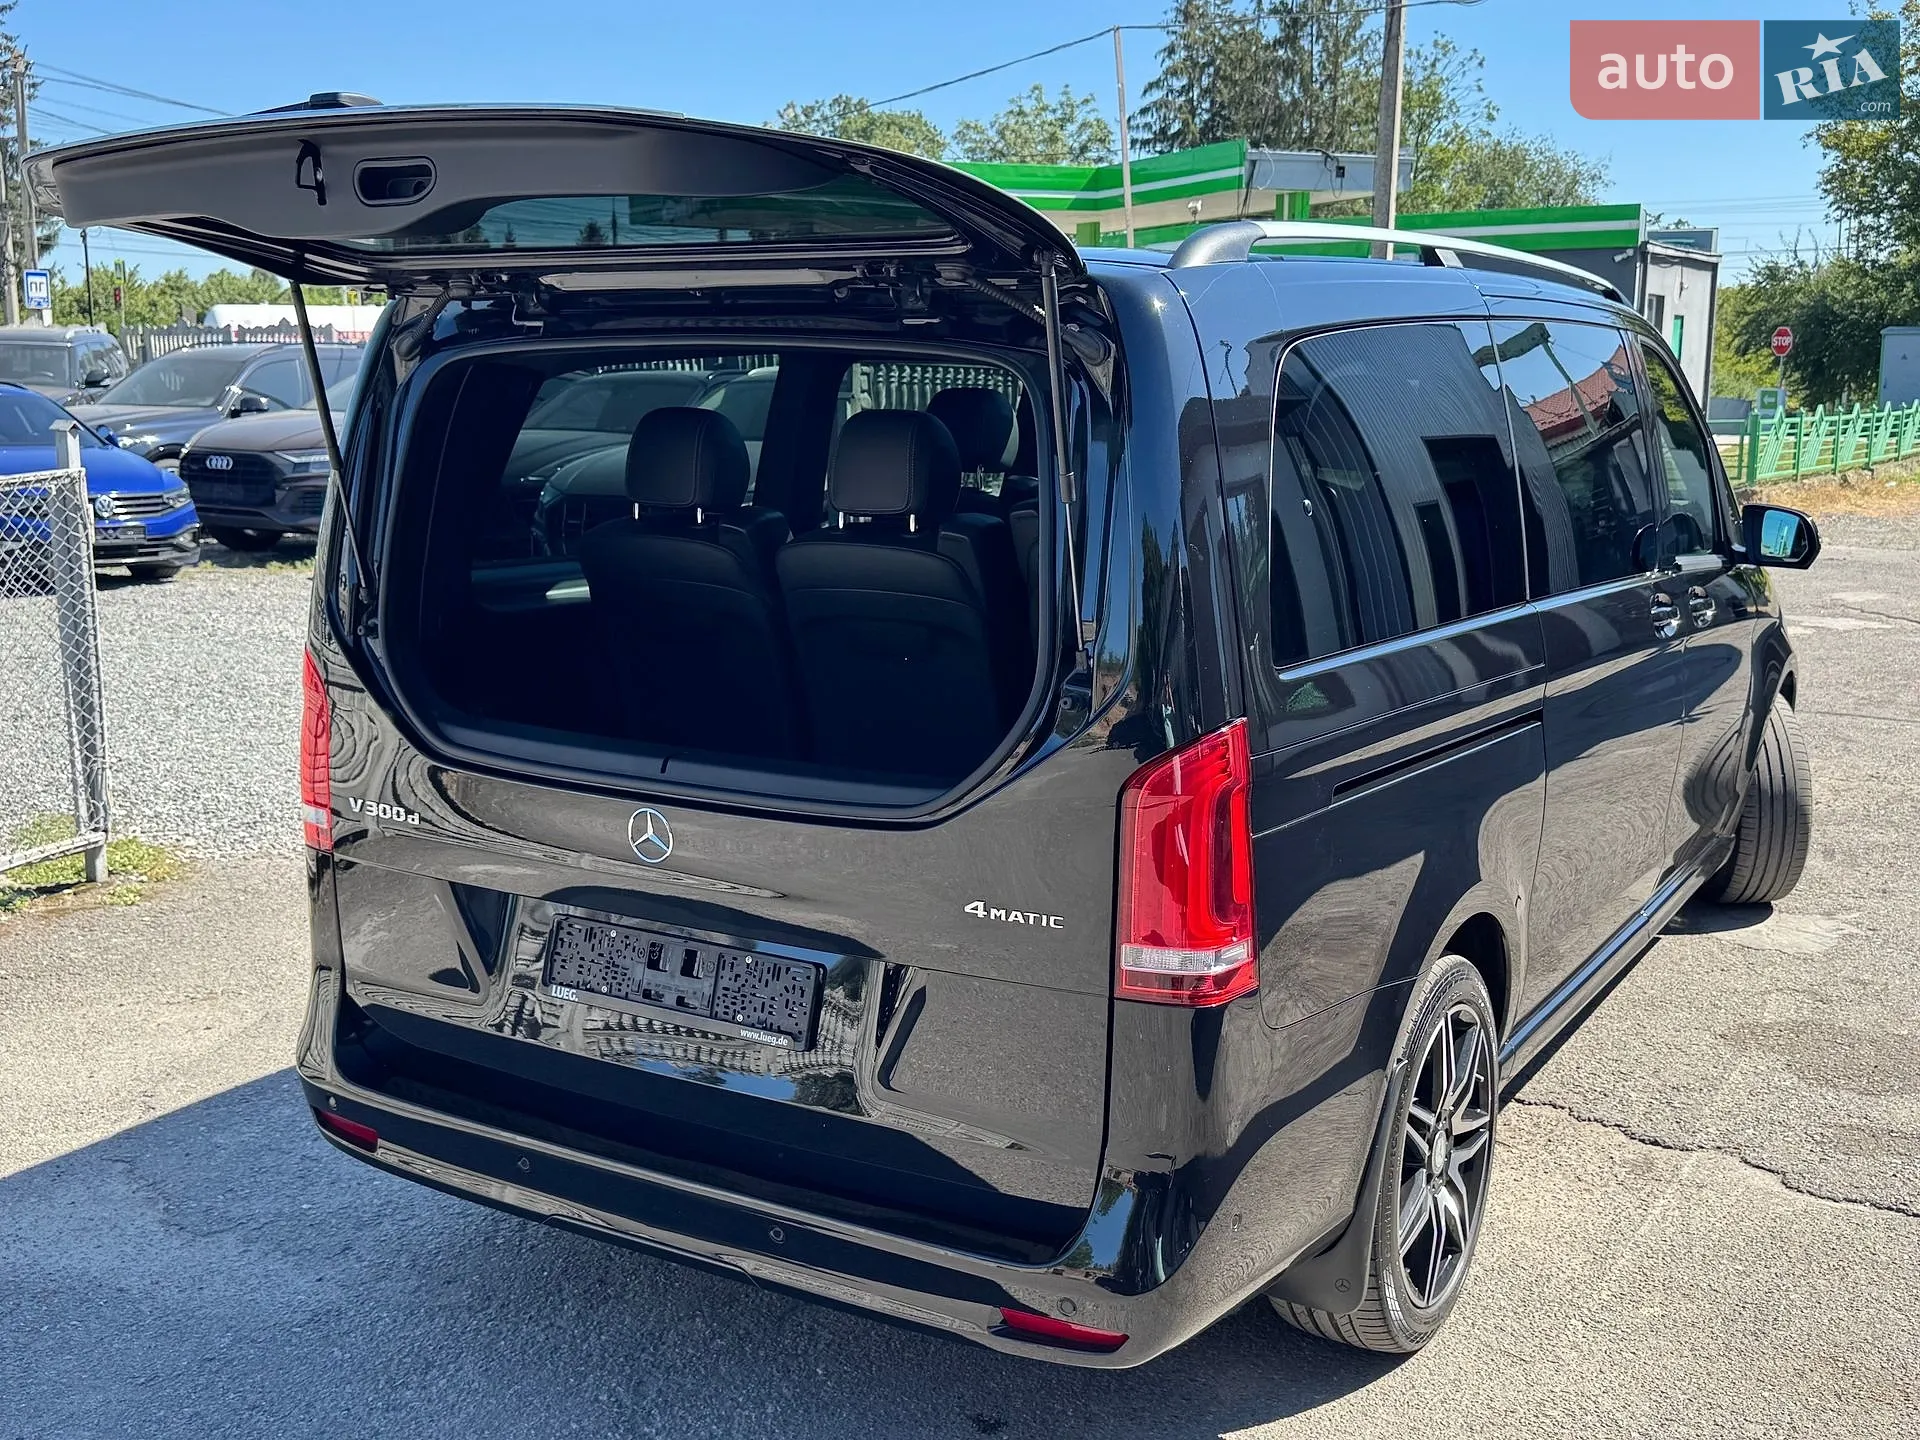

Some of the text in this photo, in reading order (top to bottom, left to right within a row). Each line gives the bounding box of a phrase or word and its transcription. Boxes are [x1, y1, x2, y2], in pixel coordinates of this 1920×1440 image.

[1772, 336, 1791, 347] STOP
[964, 901, 1064, 929] 4MATIC
[740, 1029, 788, 1046] www.lueg.de
